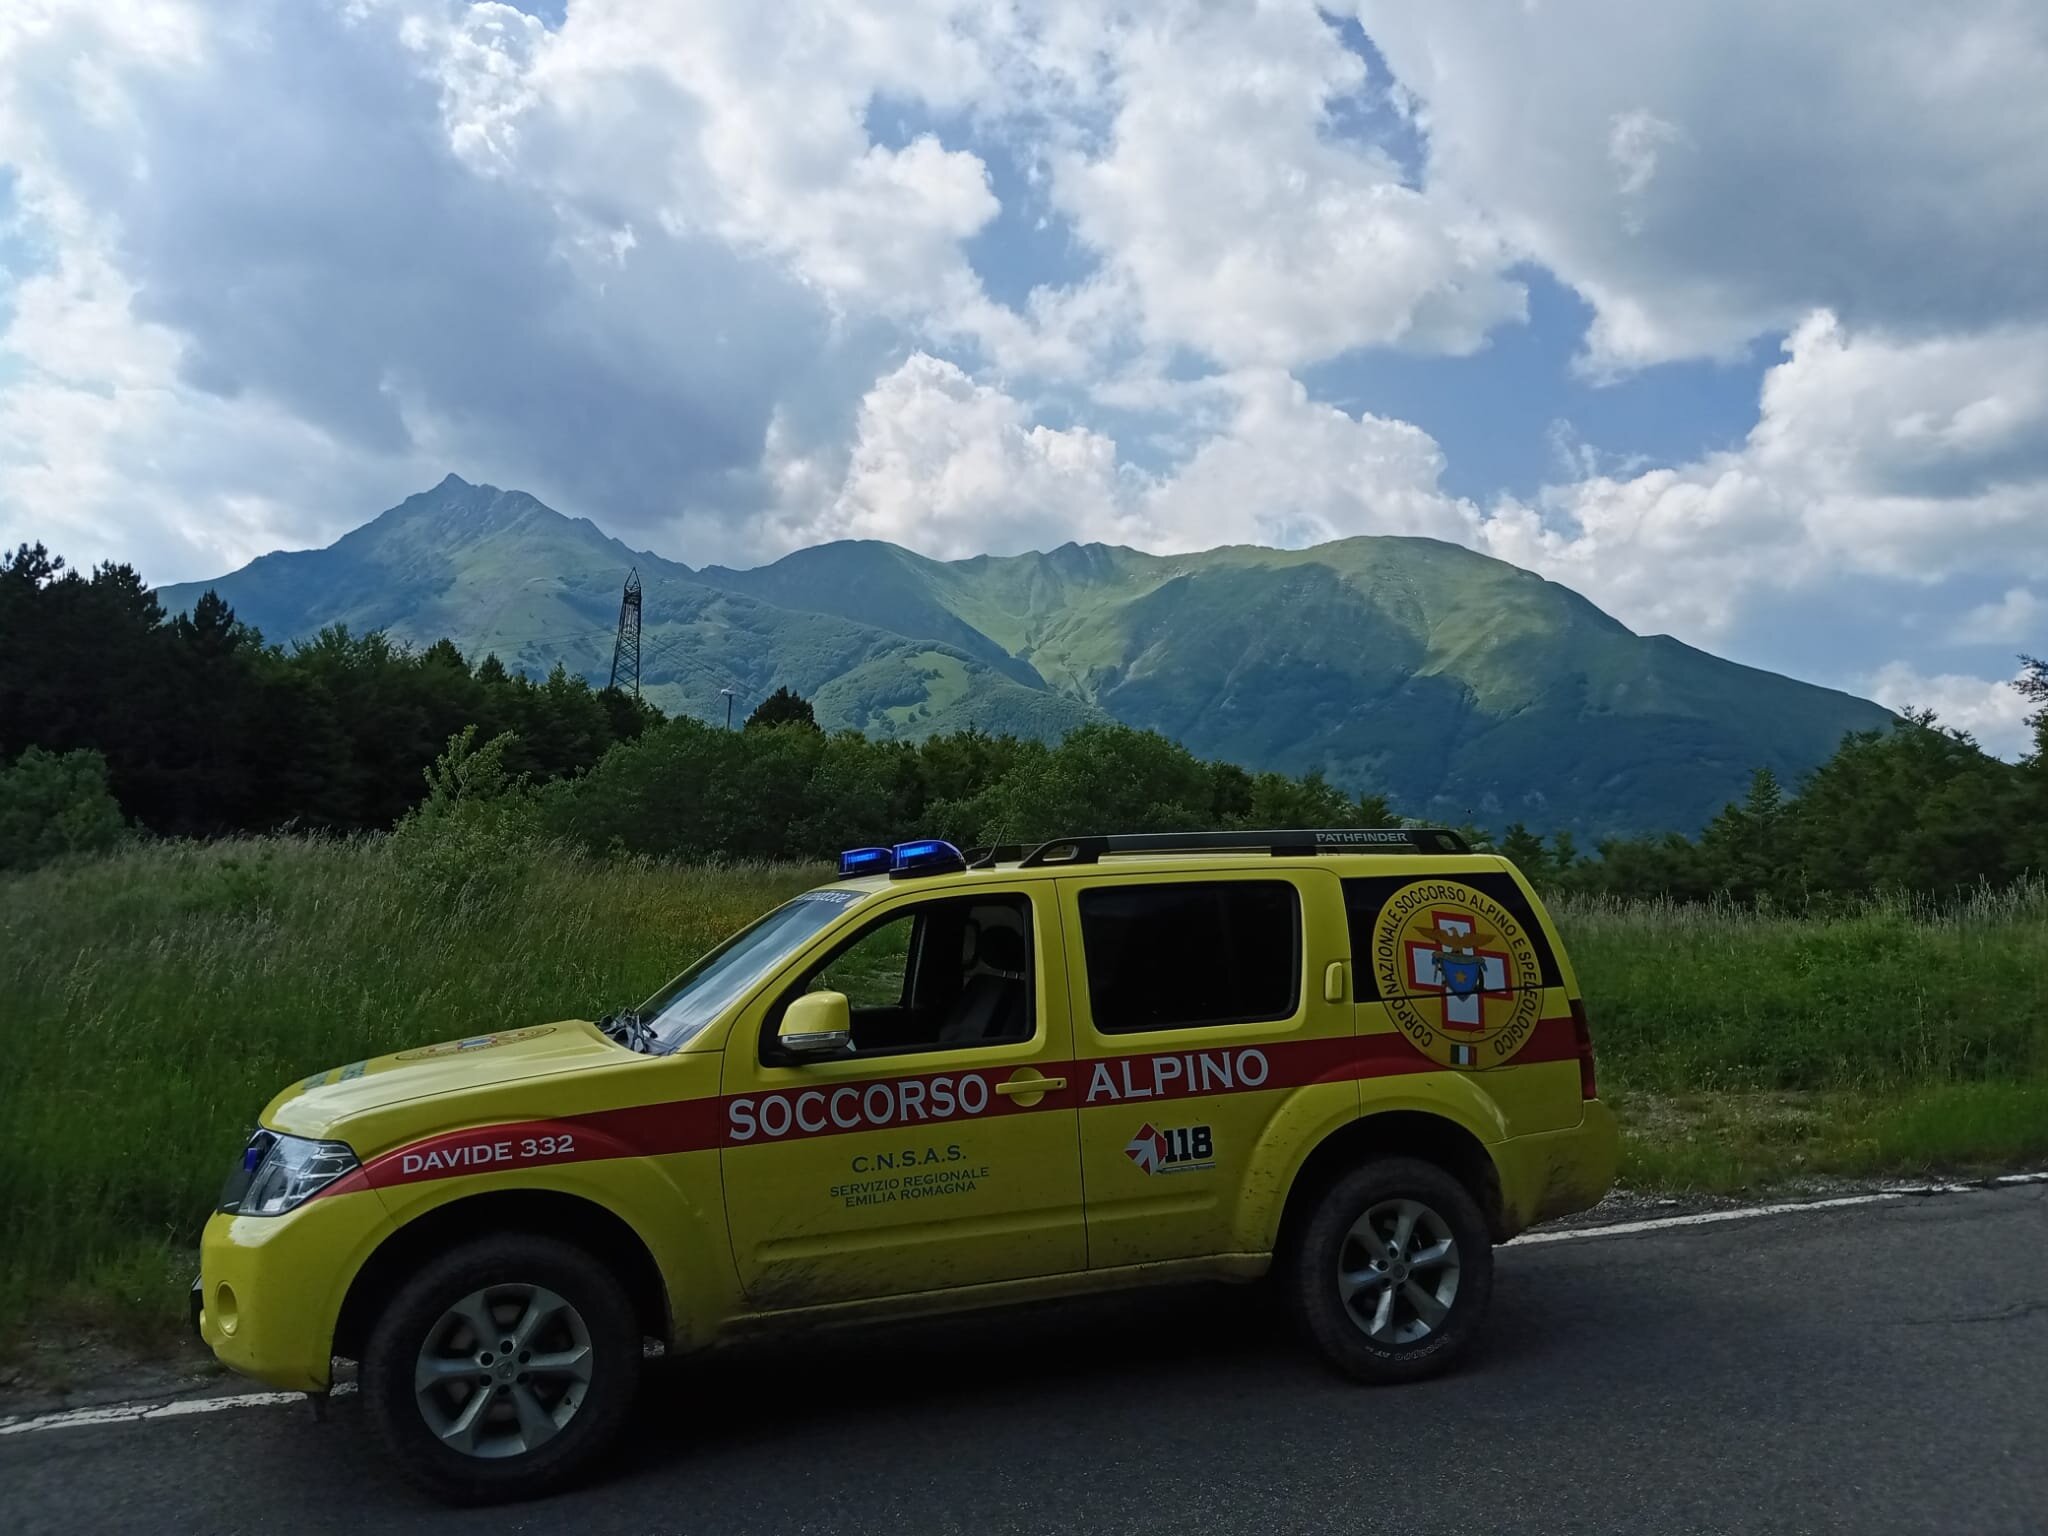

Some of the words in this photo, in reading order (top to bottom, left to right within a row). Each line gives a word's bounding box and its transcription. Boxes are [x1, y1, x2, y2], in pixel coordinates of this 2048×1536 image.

[1315, 832, 1408, 843] PATHFINDER
[1394, 885, 1466, 914] SOCCORSO
[1469, 893, 1517, 937] ALPINO
[1378, 909, 1402, 995] NAZIONALE
[1512, 938, 1526, 949] E
[1391, 996, 1433, 1047] CORPO
[1494, 951, 1538, 1056] SPELEOLOGICO
[728, 1073, 990, 1142] SOCCORSO
[1085, 1048, 1270, 1103] ALPINO
[402, 1141, 513, 1175] DAVIDE
[519, 1134, 575, 1158] 332
[851, 1144, 967, 1173] C.N.S.A.S.
[1163, 1126, 1213, 1163] 118
[830, 1177, 900, 1197] SERVIZIO
[903, 1167, 990, 1188] REGIONALE
[845, 1191, 897, 1208] EMILIA
[900, 1180, 977, 1201] ROMAGNA
